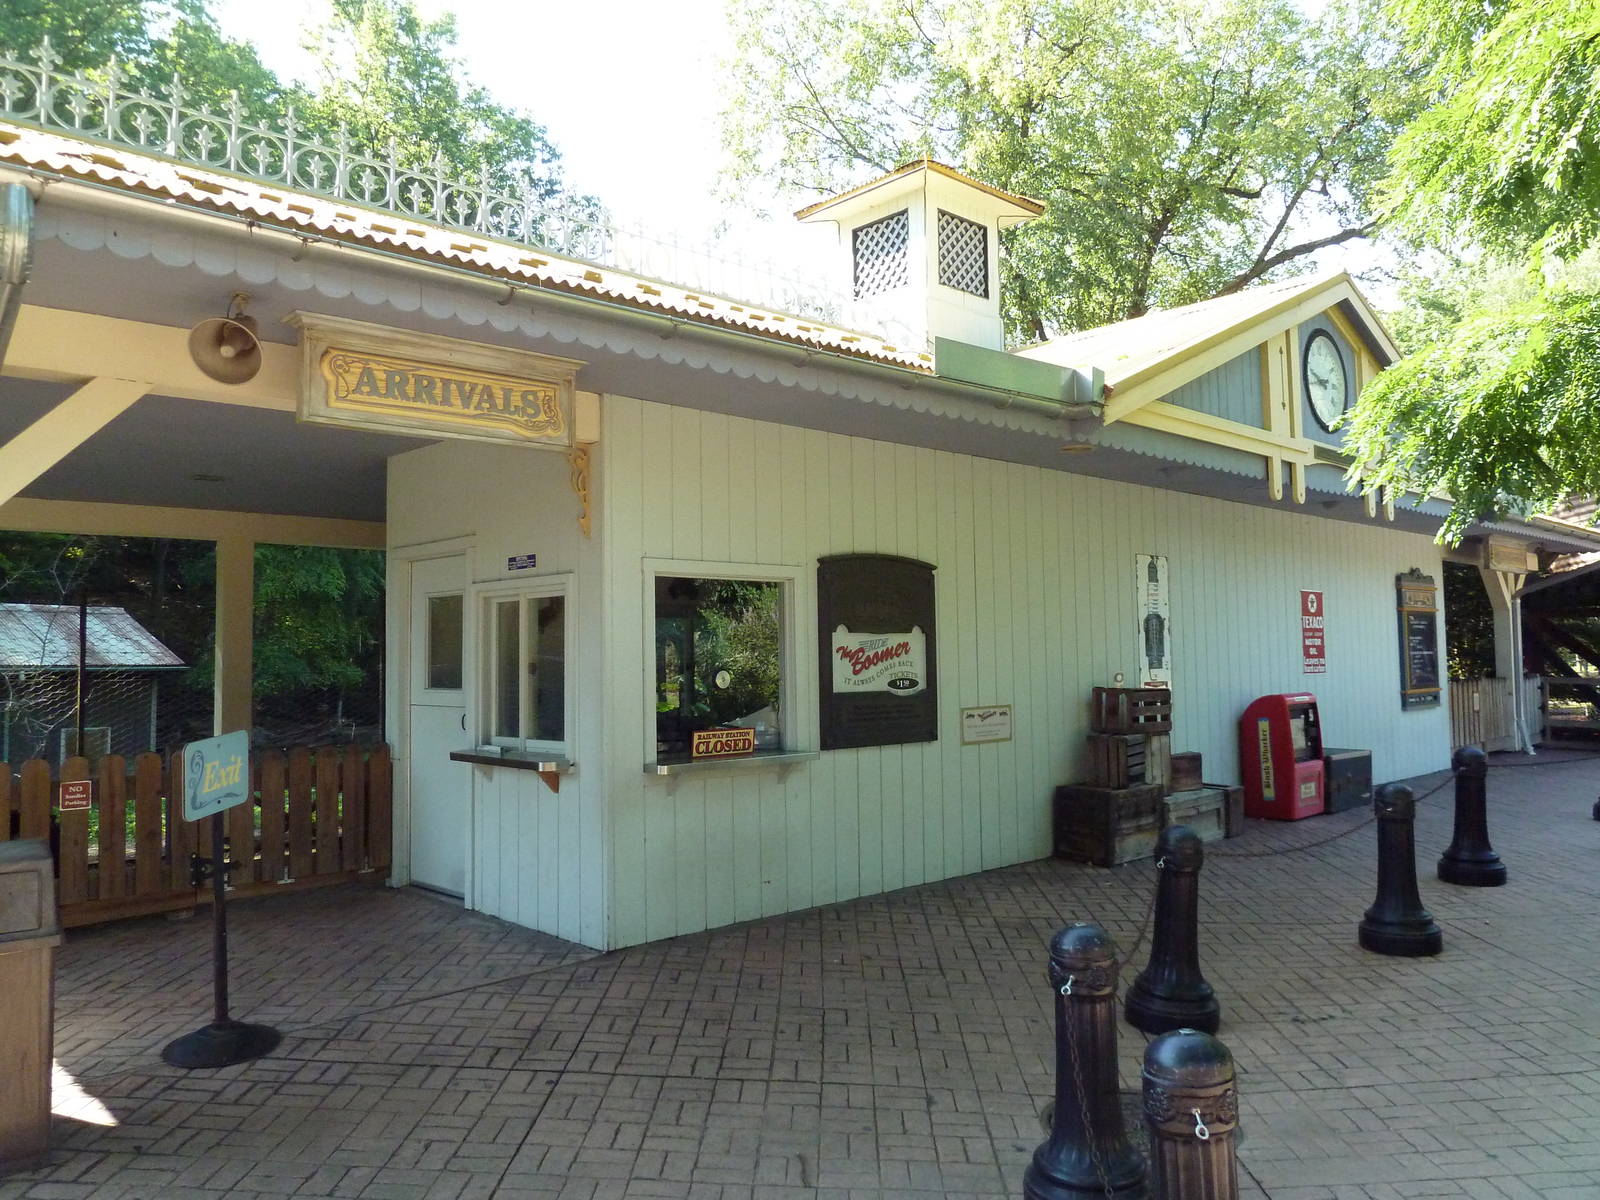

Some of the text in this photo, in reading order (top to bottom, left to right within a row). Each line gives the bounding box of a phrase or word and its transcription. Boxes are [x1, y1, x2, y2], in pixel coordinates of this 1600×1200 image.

[353, 366, 543, 420] ARRIVALS
[1303, 616, 1323, 628] TEXACO
[868, 638, 888, 652] RIDE
[849, 641, 911, 675] Boomer
[853, 676, 876, 687] ALWAYS
[876, 662, 897, 678] COMES
[898, 660, 913, 668] BACK
[889, 670, 919, 679] TICKETS
[725, 731, 751, 739] STATION
[695, 738, 752, 754] CLOSED
[203, 755, 242, 793] Exit
[69, 785, 83, 793] NO
